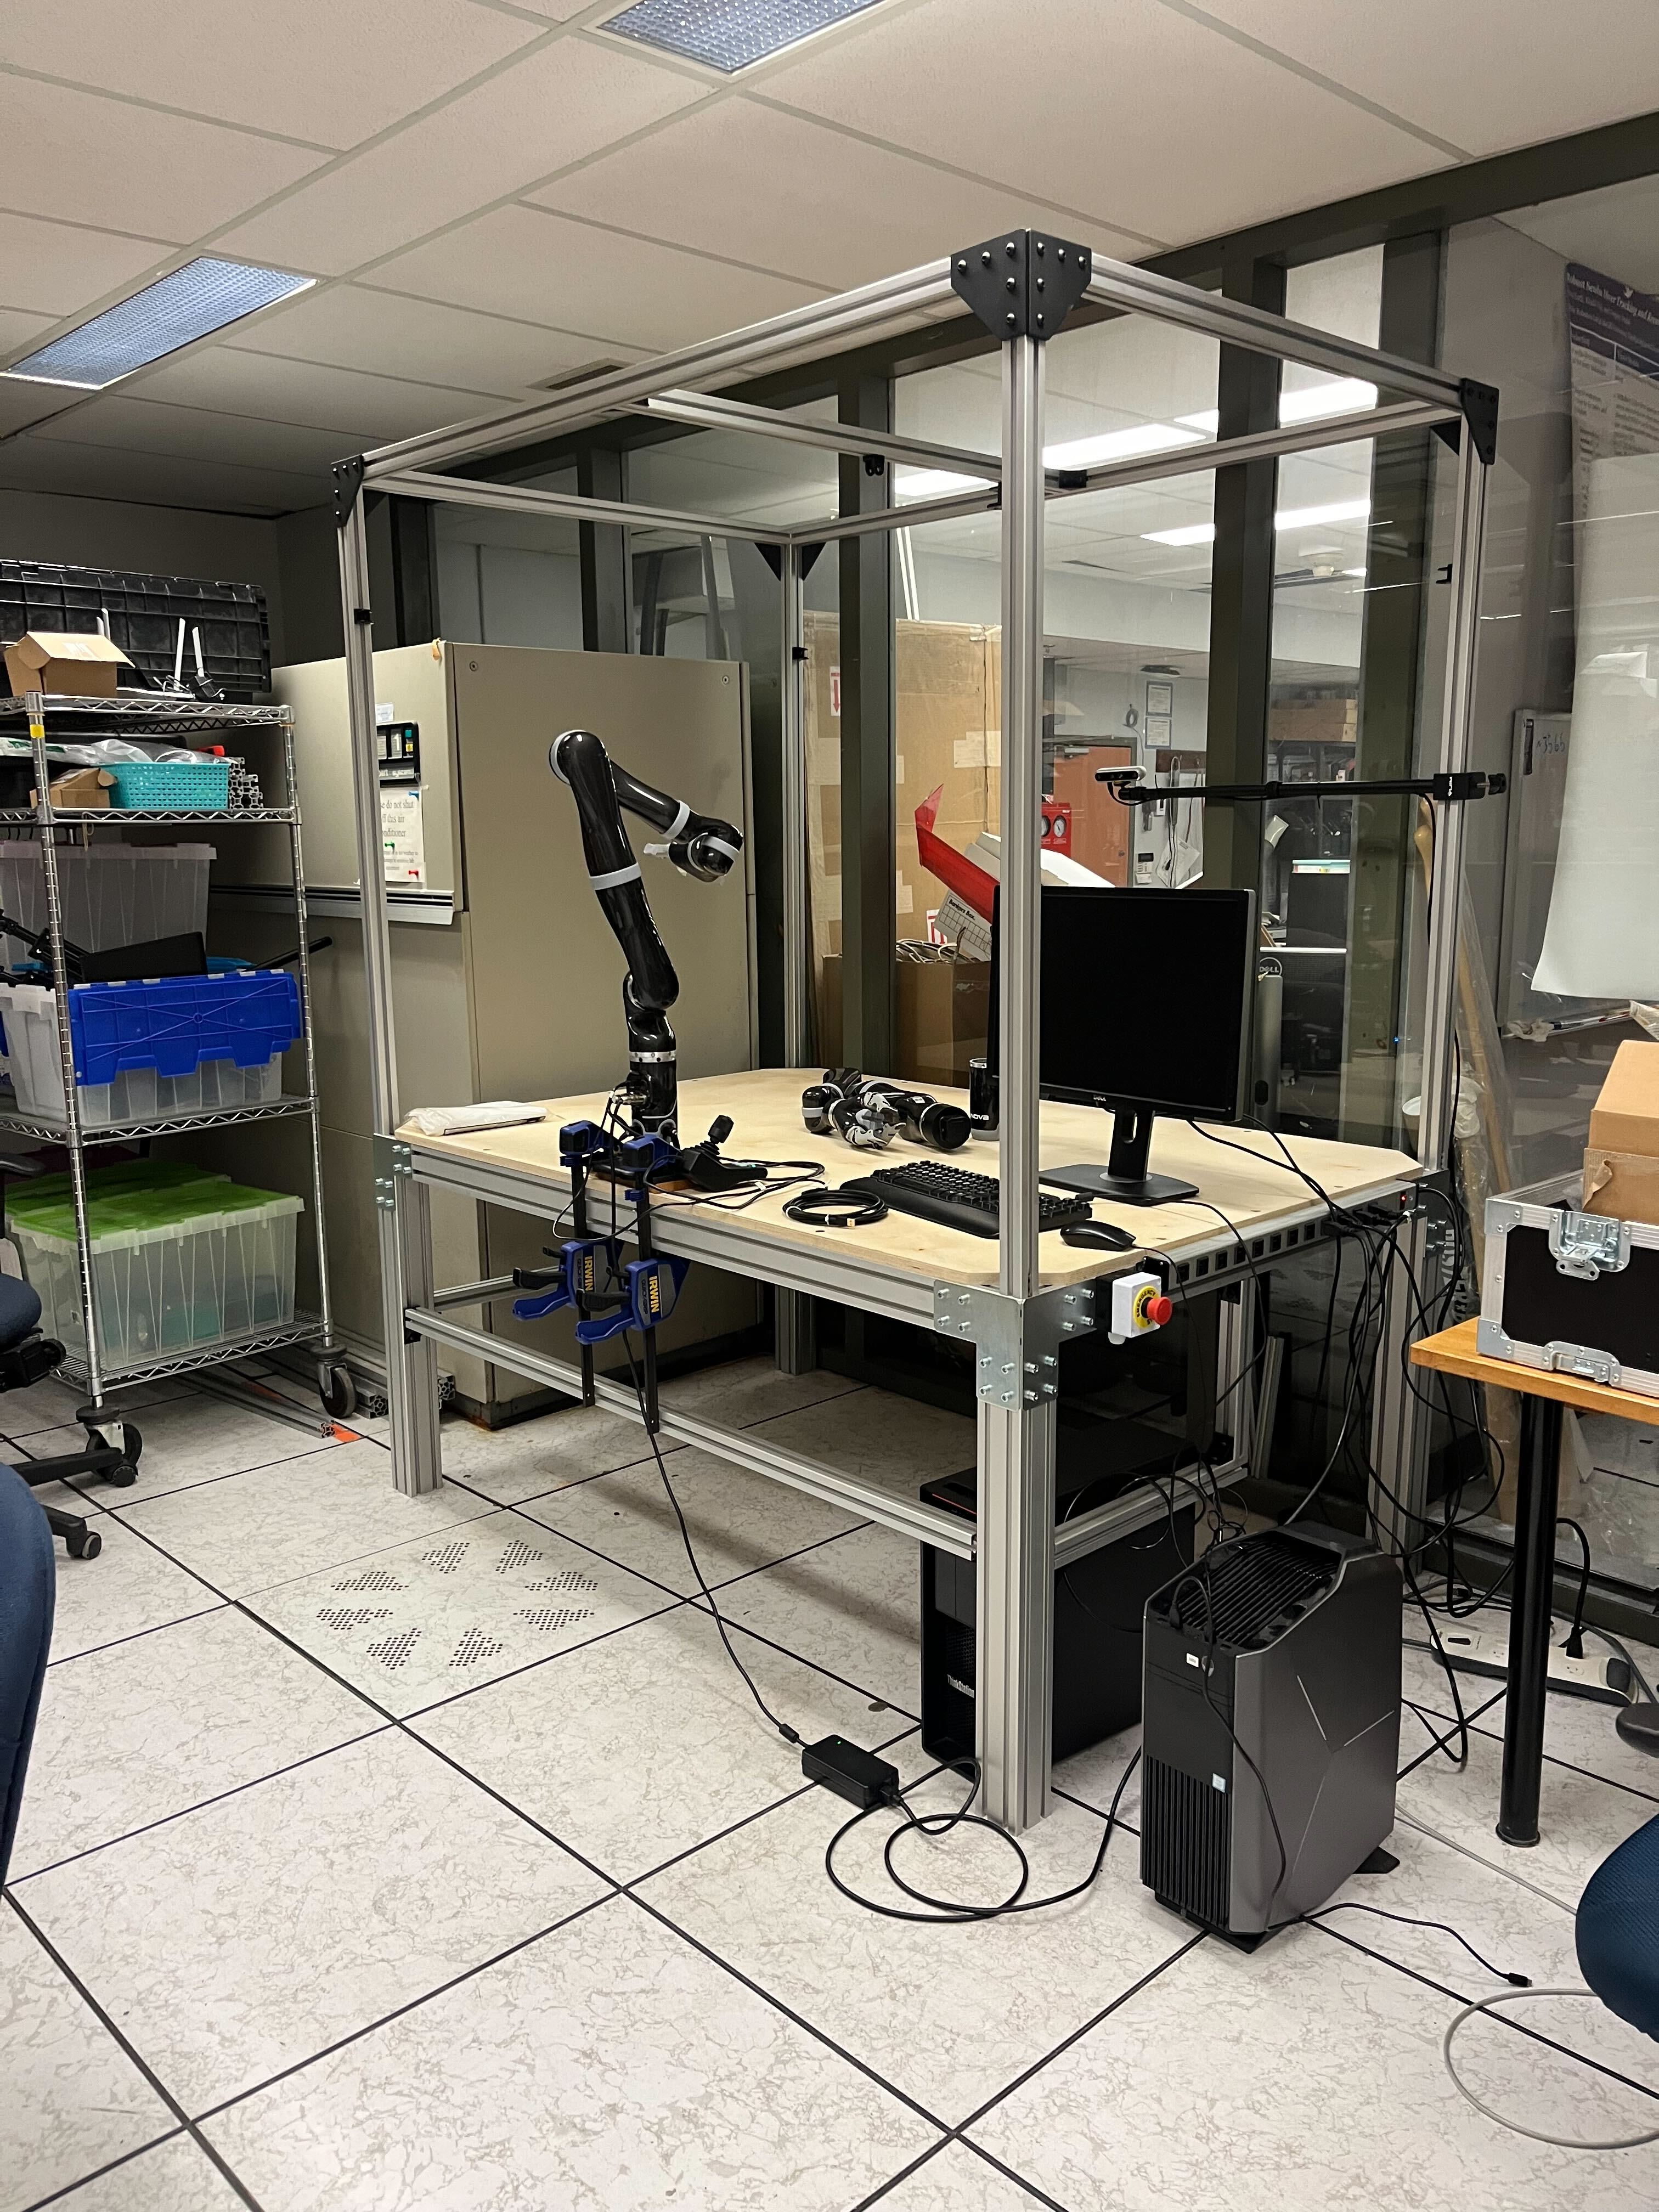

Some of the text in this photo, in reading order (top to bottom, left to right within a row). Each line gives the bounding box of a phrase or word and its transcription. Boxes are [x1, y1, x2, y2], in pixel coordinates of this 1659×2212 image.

[403, 799, 414, 808] shut
[949, 899, 966, 913] Bankers
[585, 1256, 593, 1291] IRWIN
[649, 1276, 659, 1313] IRWIN
[1137, 1290, 1156, 1318] EMERGENCY
